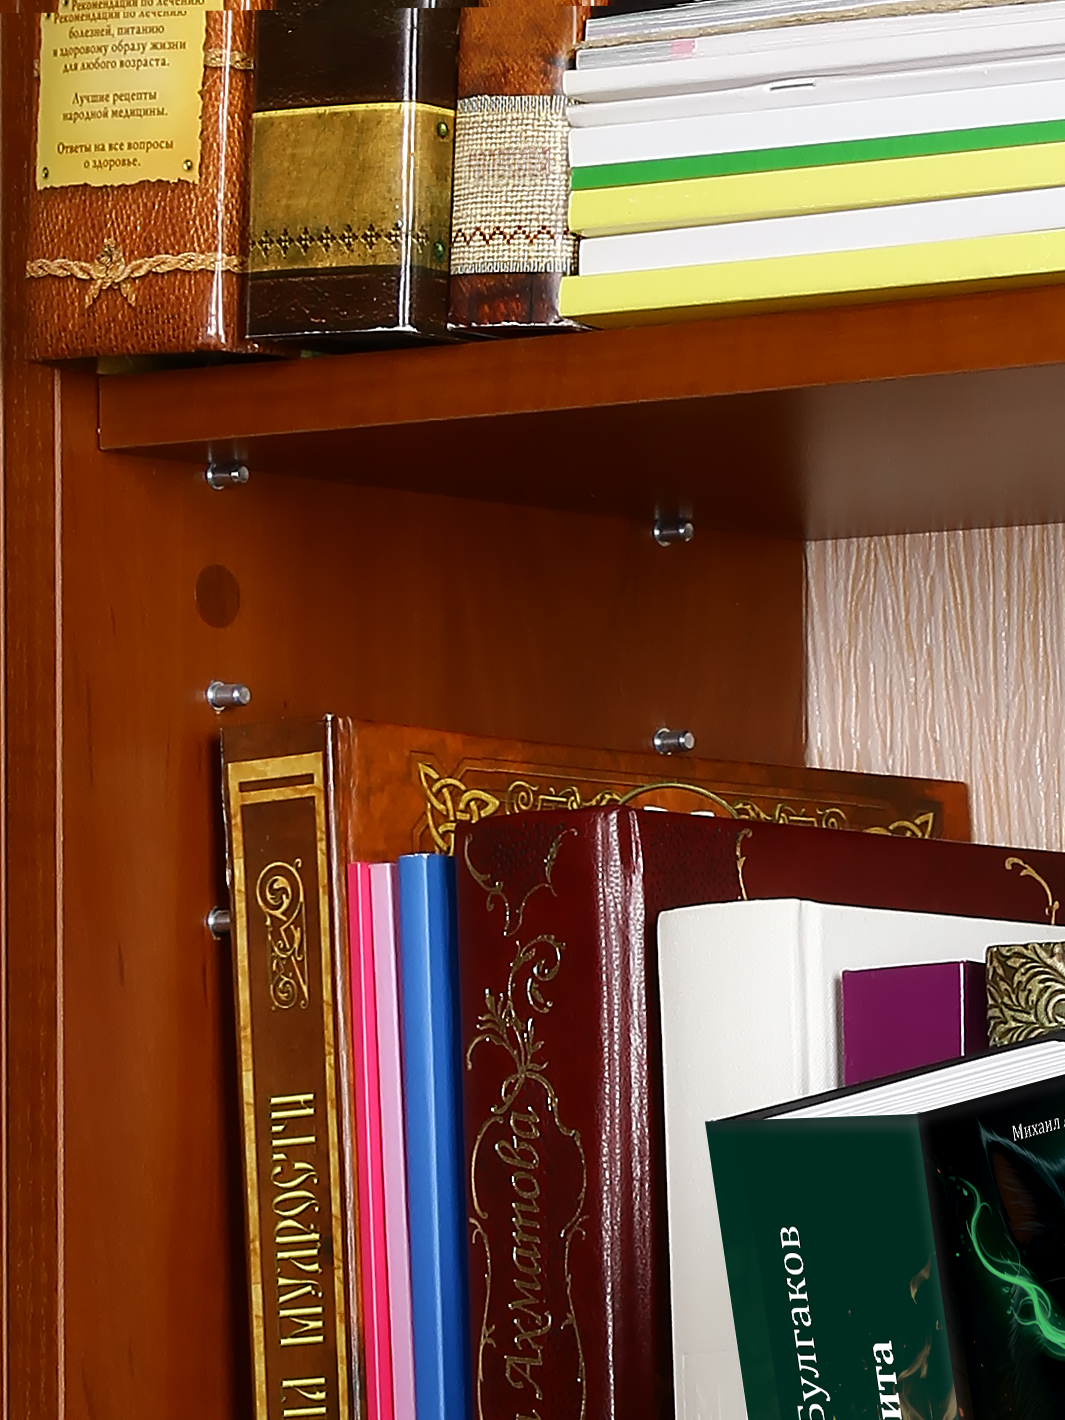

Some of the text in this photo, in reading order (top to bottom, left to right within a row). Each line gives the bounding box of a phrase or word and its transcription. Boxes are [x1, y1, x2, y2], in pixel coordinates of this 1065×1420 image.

[68, 24, 165, 39] болезней, питанию
[60, 44, 109, 58] здоровому
[111, 39, 148, 55] образу
[149, 41, 187, 50] жизни
[63, 57, 170, 74] для любого возраста.
[72, 91, 157, 107] Лучшие рецепты
[62, 107, 168, 124] народной медицины.
[57, 140, 174, 155] Ответы на все вопросы
[83, 158, 141, 171] о здоровье.
[1012, 1116, 1061, 1142] Михаил
[270, 1093, 324, 1346] МУДРОСТИ
[495, 1105, 552, 1400] Ахматова
